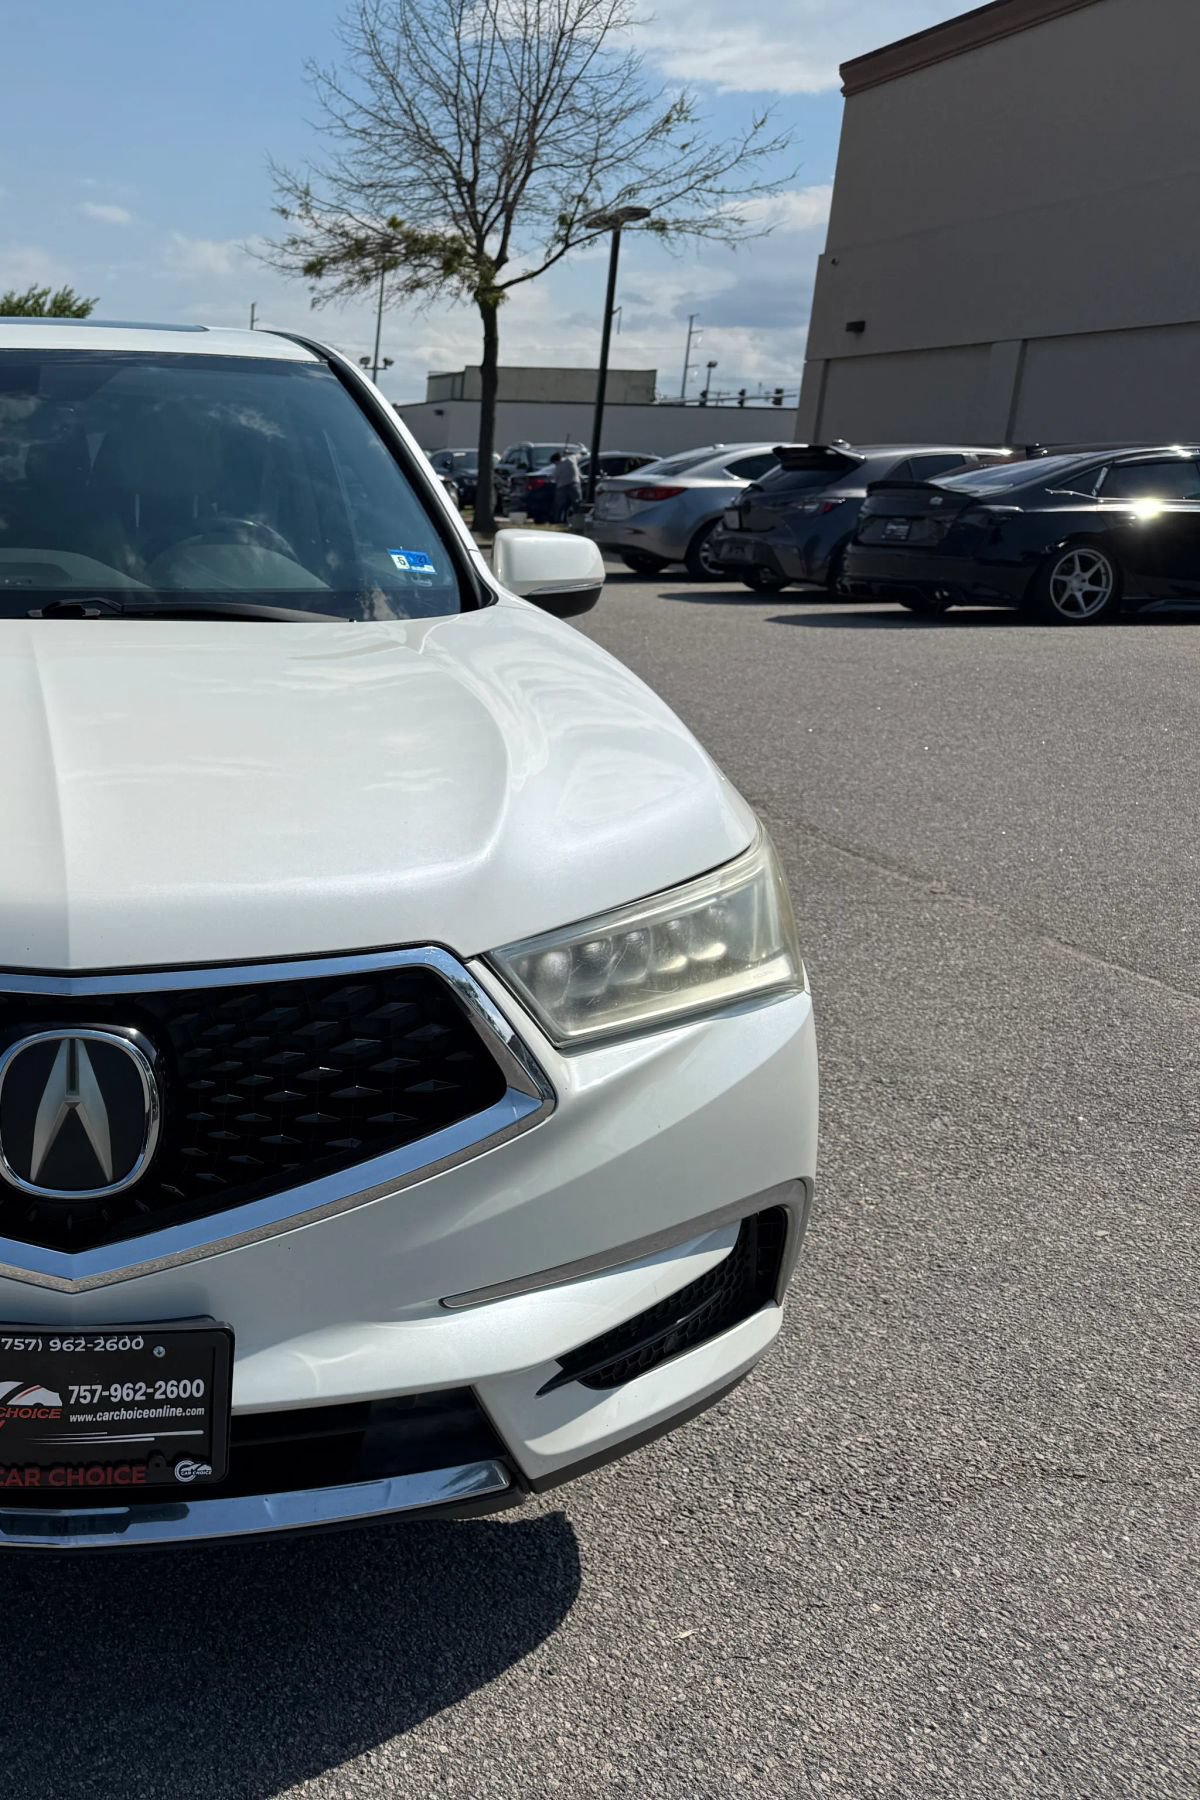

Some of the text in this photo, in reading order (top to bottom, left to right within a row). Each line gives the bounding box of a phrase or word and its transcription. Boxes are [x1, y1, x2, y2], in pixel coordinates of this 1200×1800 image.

[49, 1336, 145, 1351] 962-2600
[68, 1379, 205, 1405] 757-962-2600
[69, 1405, 205, 1423] www.carchoiceonline.com
[49, 1466, 147, 1486] CHOICE
